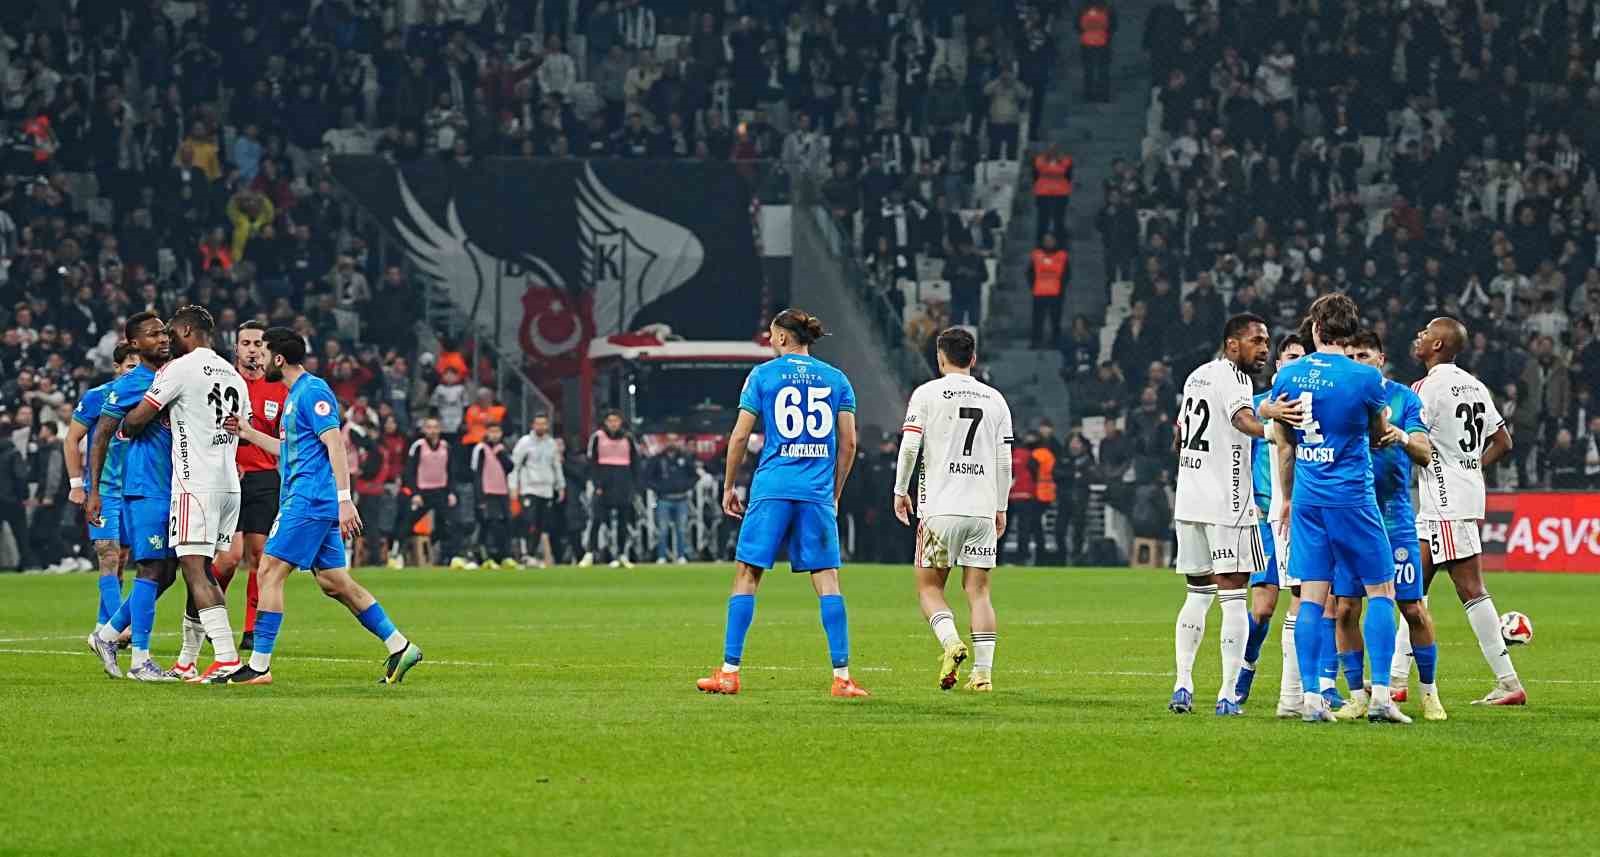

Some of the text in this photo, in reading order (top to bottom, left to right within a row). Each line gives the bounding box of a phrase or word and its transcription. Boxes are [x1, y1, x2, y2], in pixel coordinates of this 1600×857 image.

[774, 386, 833, 438] 65
[959, 407, 984, 457] 7
[949, 462, 985, 476] RASHICA
[1394, 562, 1415, 584] 70
